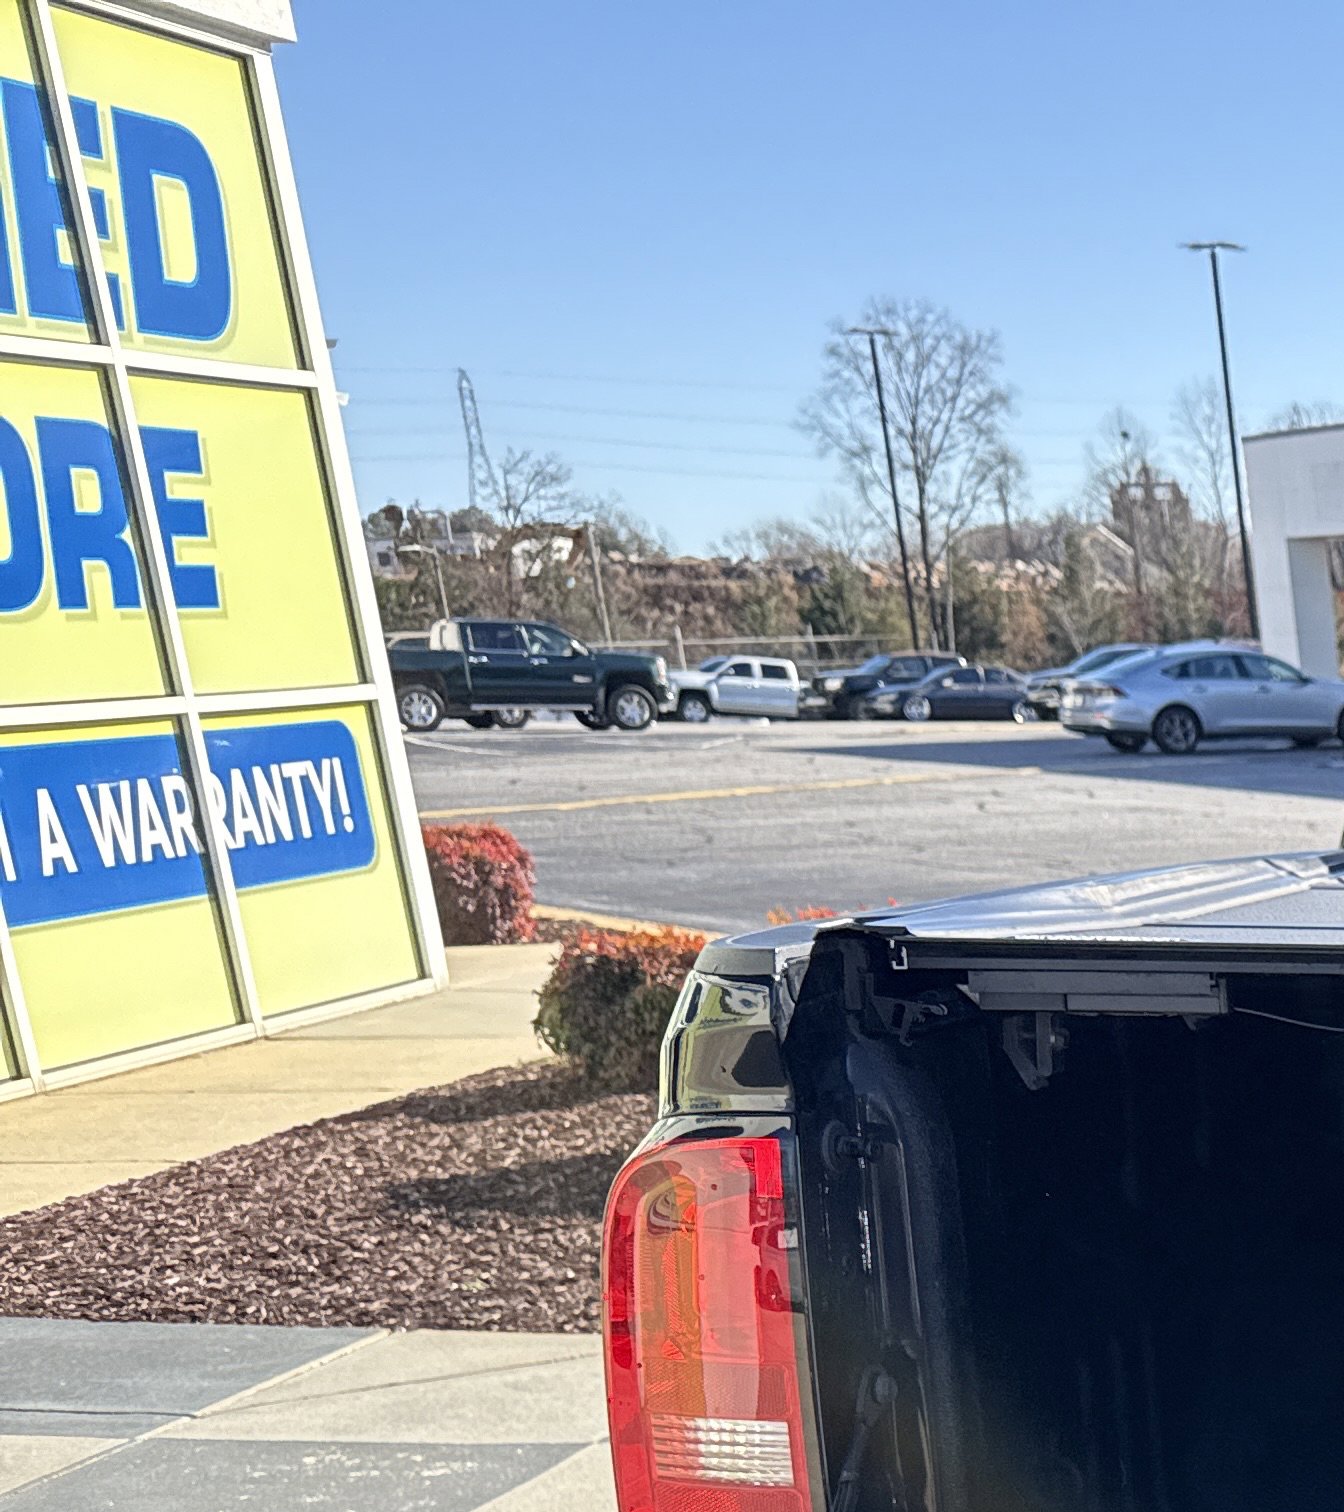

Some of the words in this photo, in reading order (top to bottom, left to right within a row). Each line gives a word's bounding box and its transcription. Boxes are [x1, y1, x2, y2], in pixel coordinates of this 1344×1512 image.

[0, 76, 231, 342] ED
[37, 788, 78, 876] A
[76, 757, 354, 868] WARRANTY!
